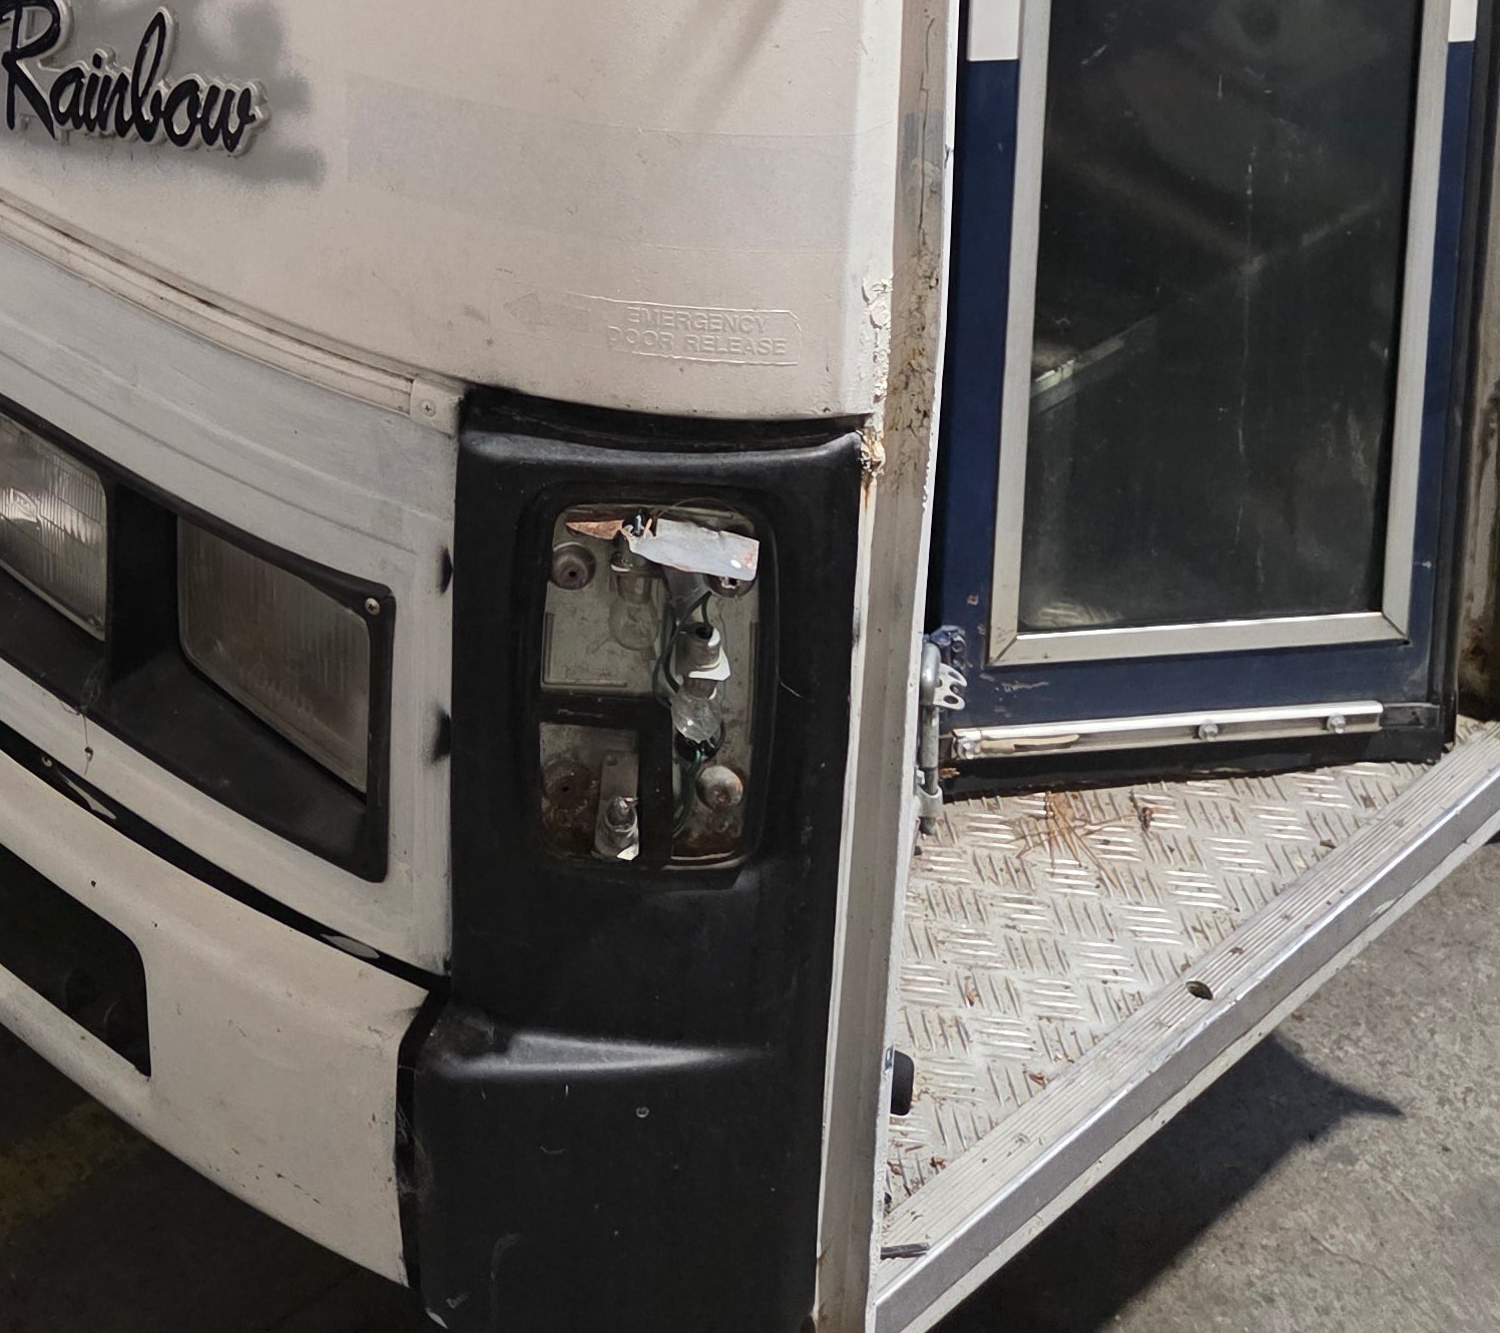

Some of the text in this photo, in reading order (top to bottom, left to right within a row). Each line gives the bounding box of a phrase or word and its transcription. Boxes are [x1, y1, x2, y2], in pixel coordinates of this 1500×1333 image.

[625, 306, 770, 334] EMERGENCY
[607, 325, 788, 356] DOOR RELEASE
